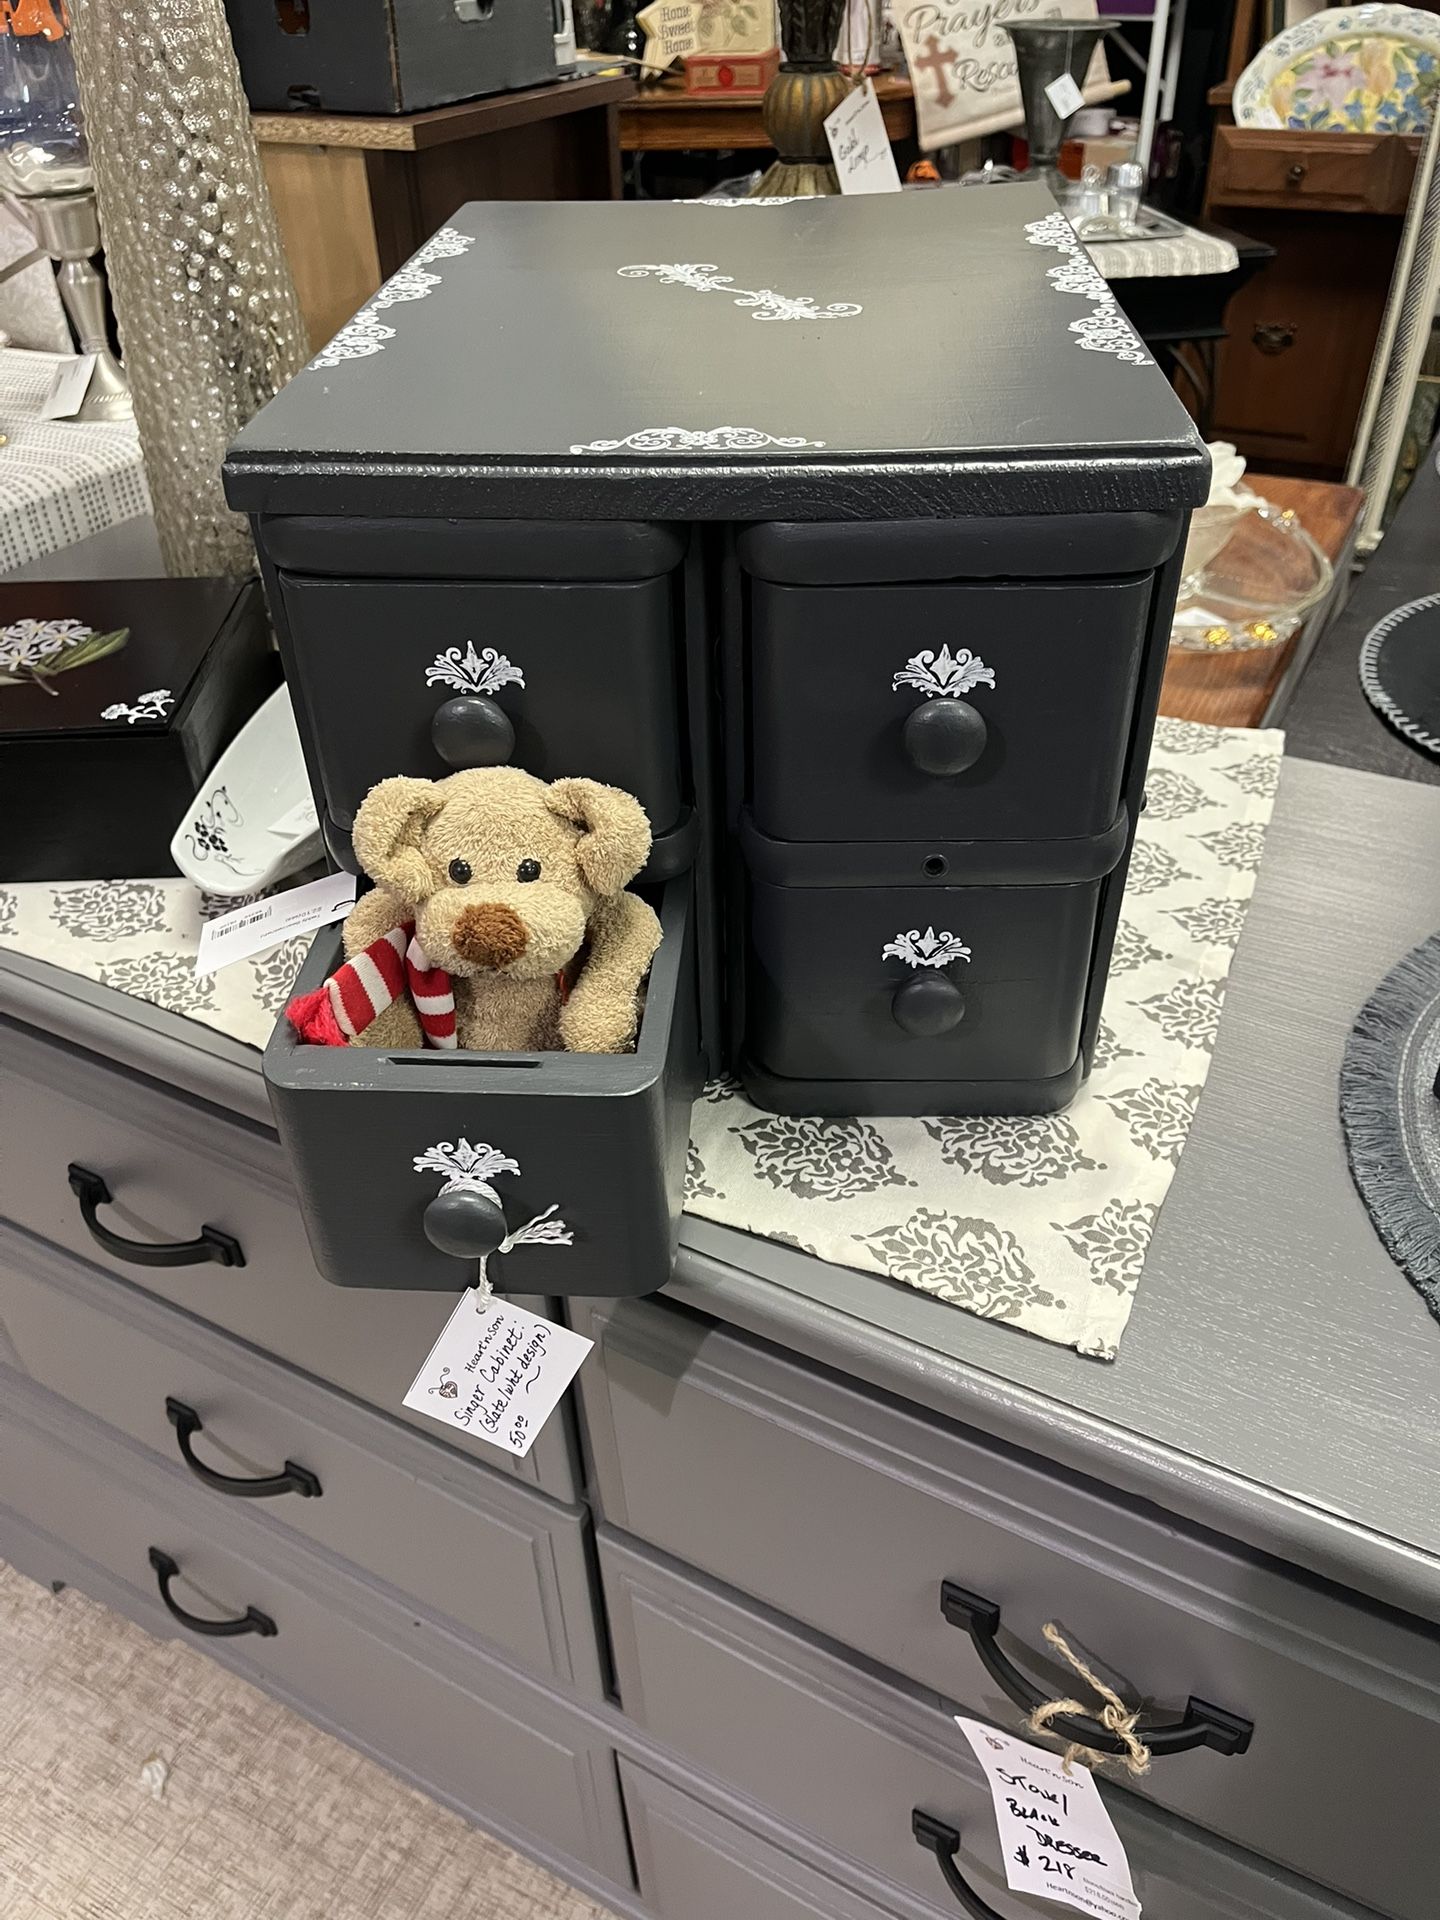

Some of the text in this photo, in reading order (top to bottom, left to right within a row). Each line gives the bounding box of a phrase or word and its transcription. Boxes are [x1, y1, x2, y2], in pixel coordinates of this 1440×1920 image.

[661, 6, 691, 21] Home
[903, 0, 1040, 48] Prayers
[658, 20, 695, 39] Sweet
[664, 38, 693, 54] Home
[478, 1324, 552, 1434] (slate/wht design)
[454, 1384, 489, 1426] Singer
[1006, 1797, 1060, 1827] BLACK
